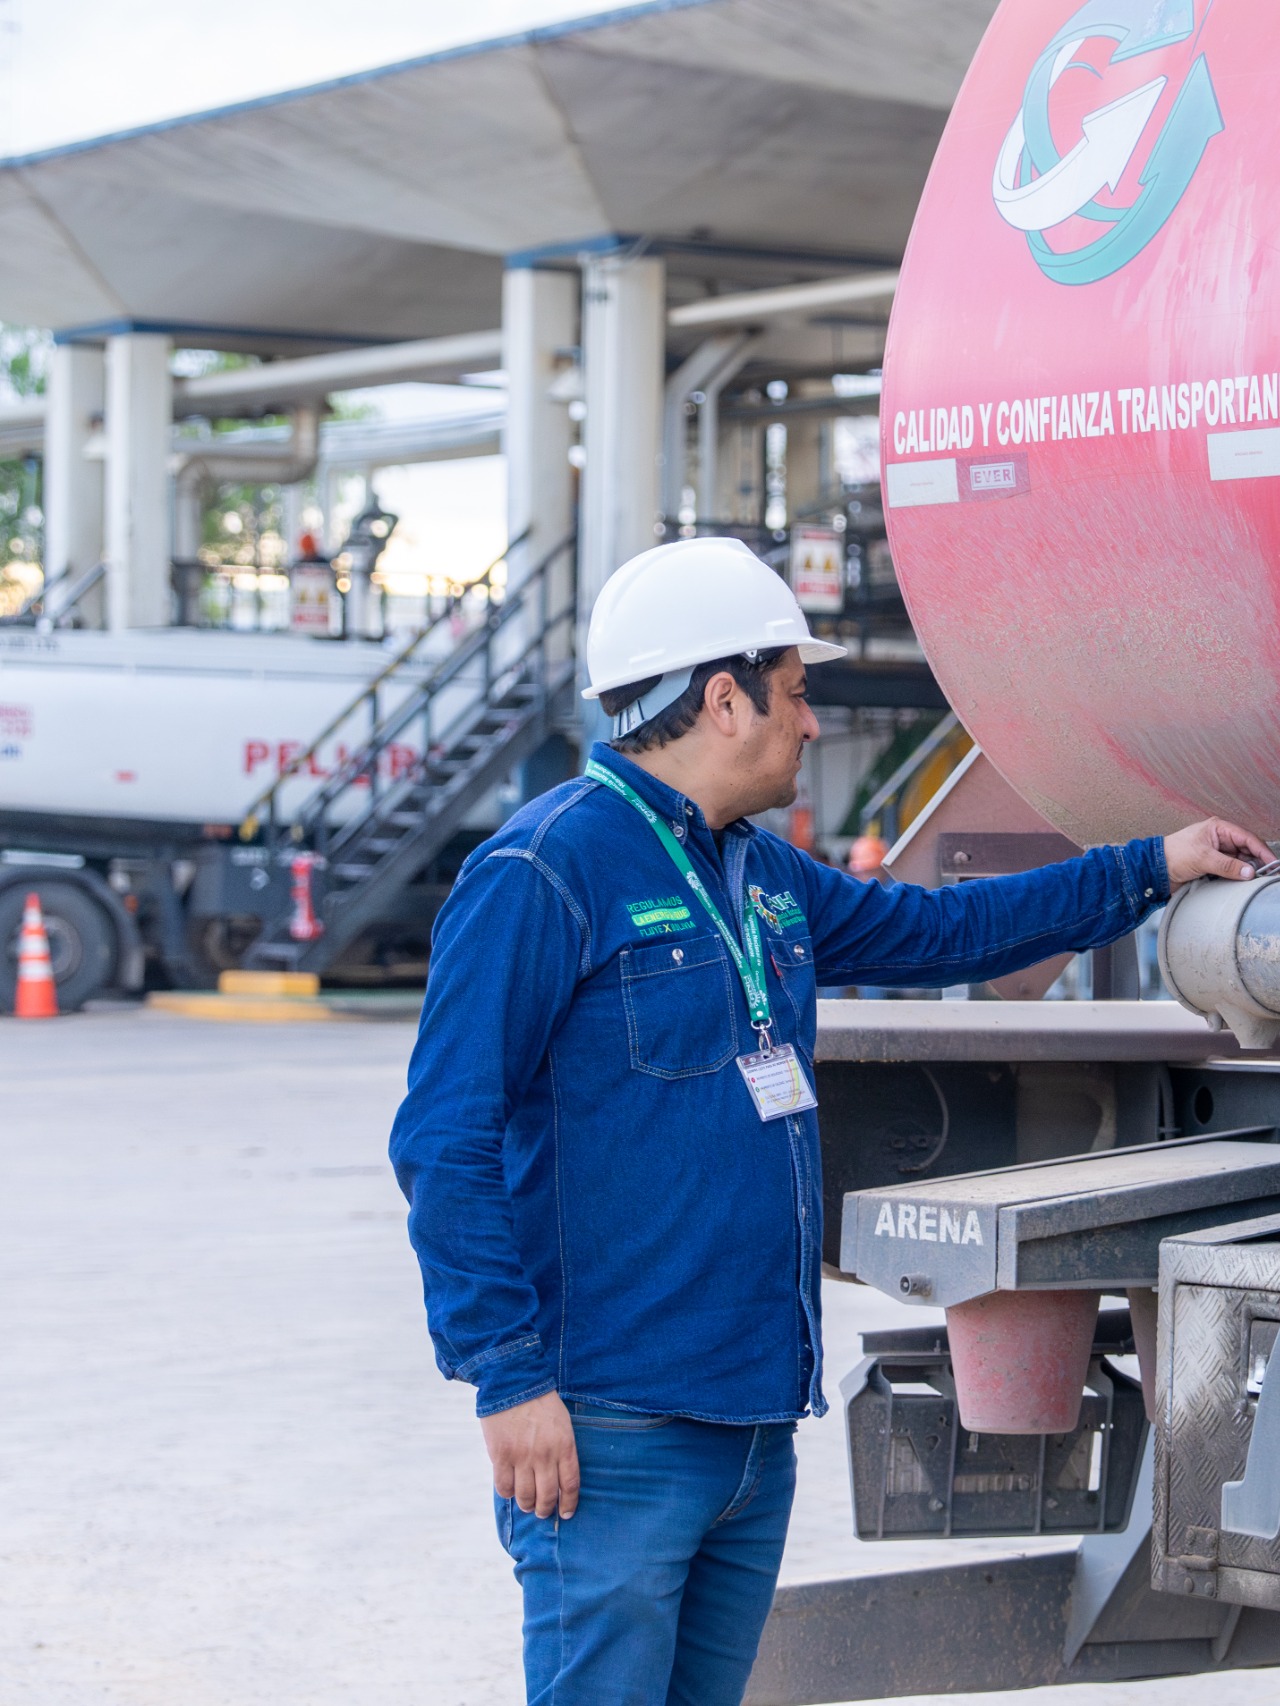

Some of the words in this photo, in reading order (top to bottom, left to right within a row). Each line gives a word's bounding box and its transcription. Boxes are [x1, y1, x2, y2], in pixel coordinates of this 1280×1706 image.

[893, 405, 974, 455] CALIDAD
[978, 402, 993, 447] Y
[996, 390, 1115, 446] CONFIANZA
[973, 468, 1012, 484] EVER
[626, 896, 683, 913] REGULAMOS
[662, 924, 673, 933] X
[874, 1201, 984, 1247] ARENA
